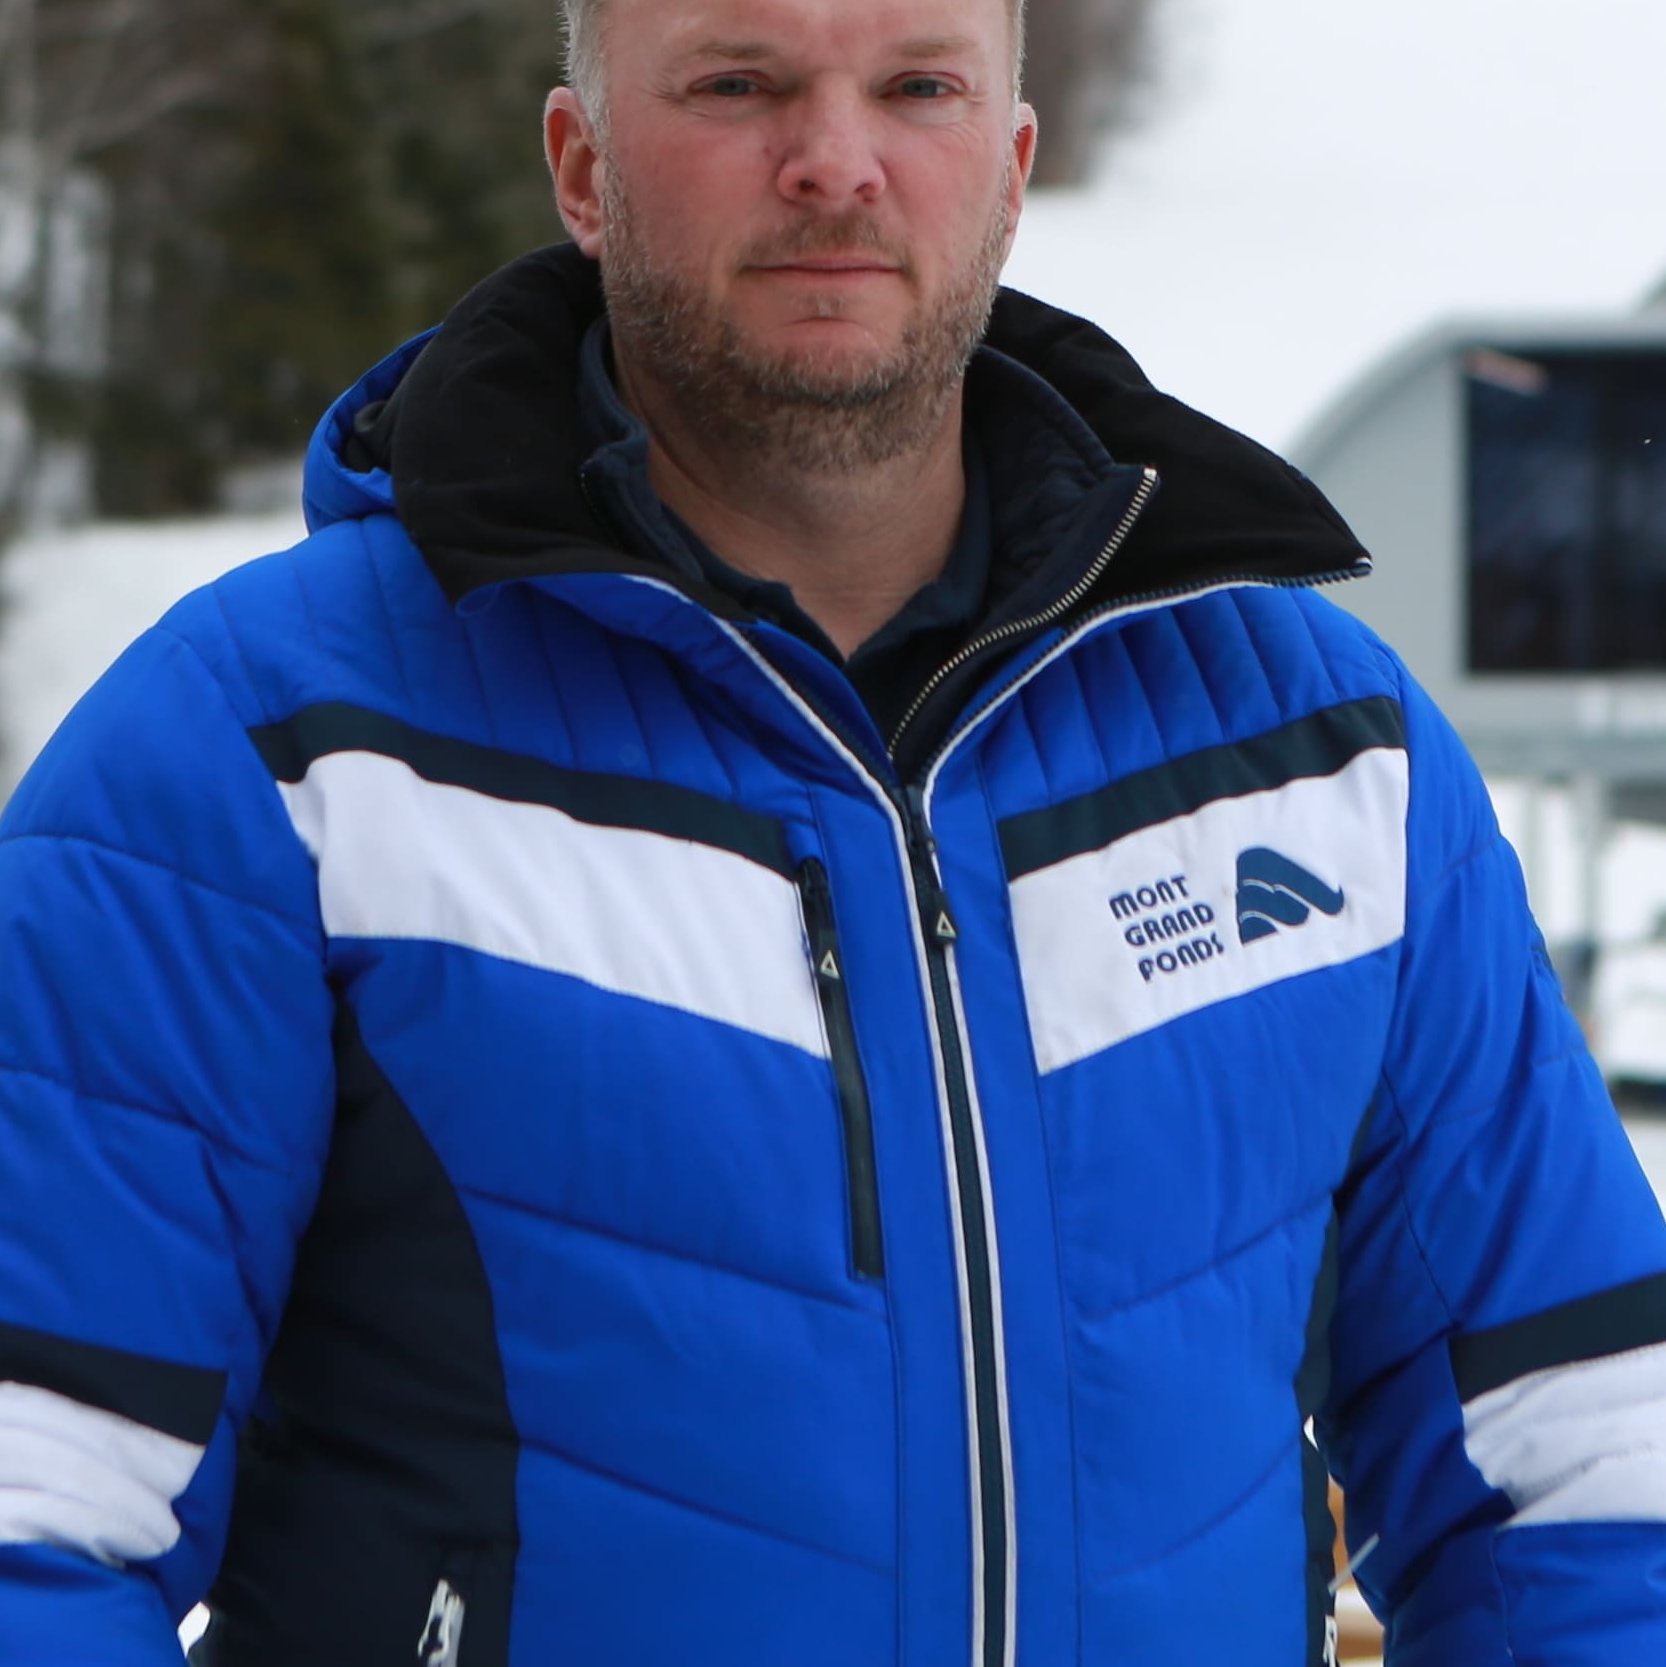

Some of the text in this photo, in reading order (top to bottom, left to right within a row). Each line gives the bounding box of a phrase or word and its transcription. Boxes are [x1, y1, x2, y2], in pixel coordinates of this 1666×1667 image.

[1109, 875, 1189, 920] MONT
[1124, 902, 1215, 947] GRAND
[1137, 931, 1225, 983] FONDS
